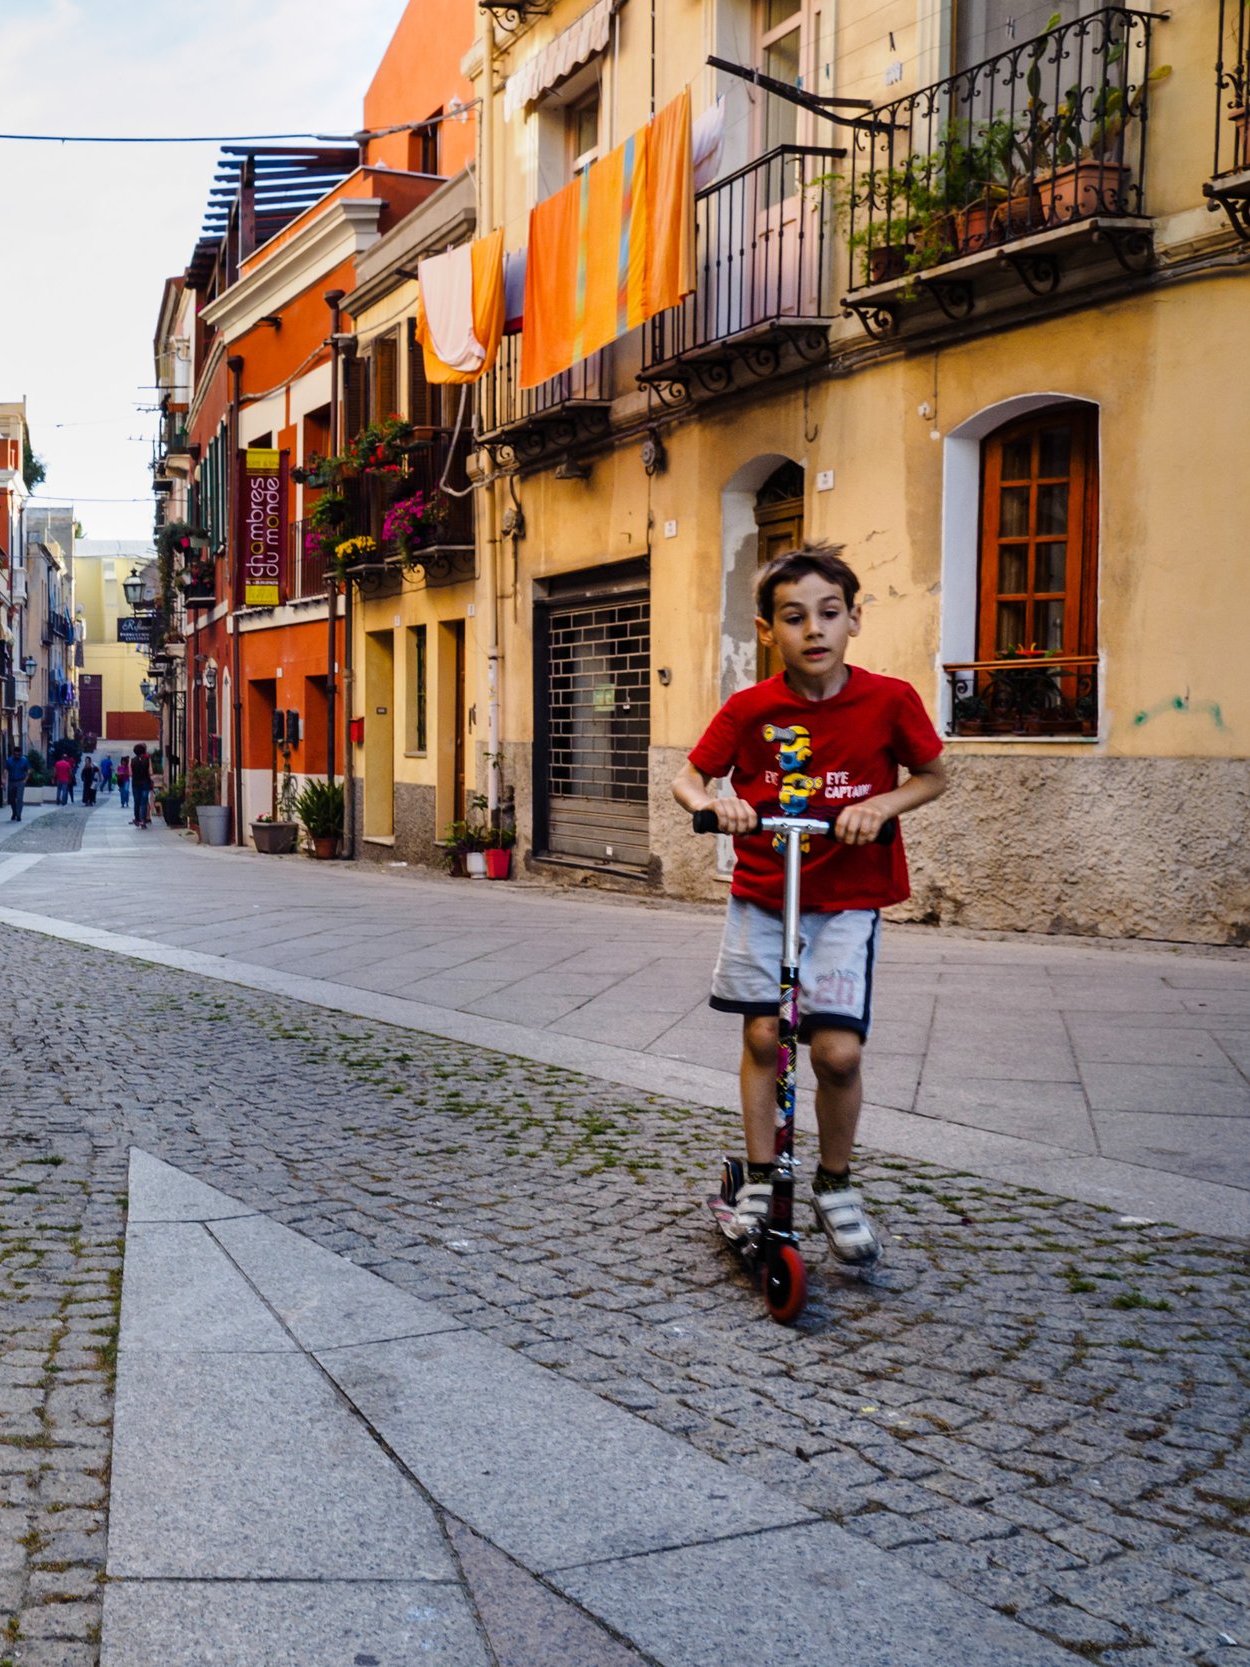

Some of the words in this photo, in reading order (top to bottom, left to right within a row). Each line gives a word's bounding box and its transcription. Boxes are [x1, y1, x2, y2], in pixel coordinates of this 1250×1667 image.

[246, 477, 264, 577] chambres
[264, 477, 279, 545] monde
[265, 552, 279, 577] du
[826, 771, 849, 785] EYE
